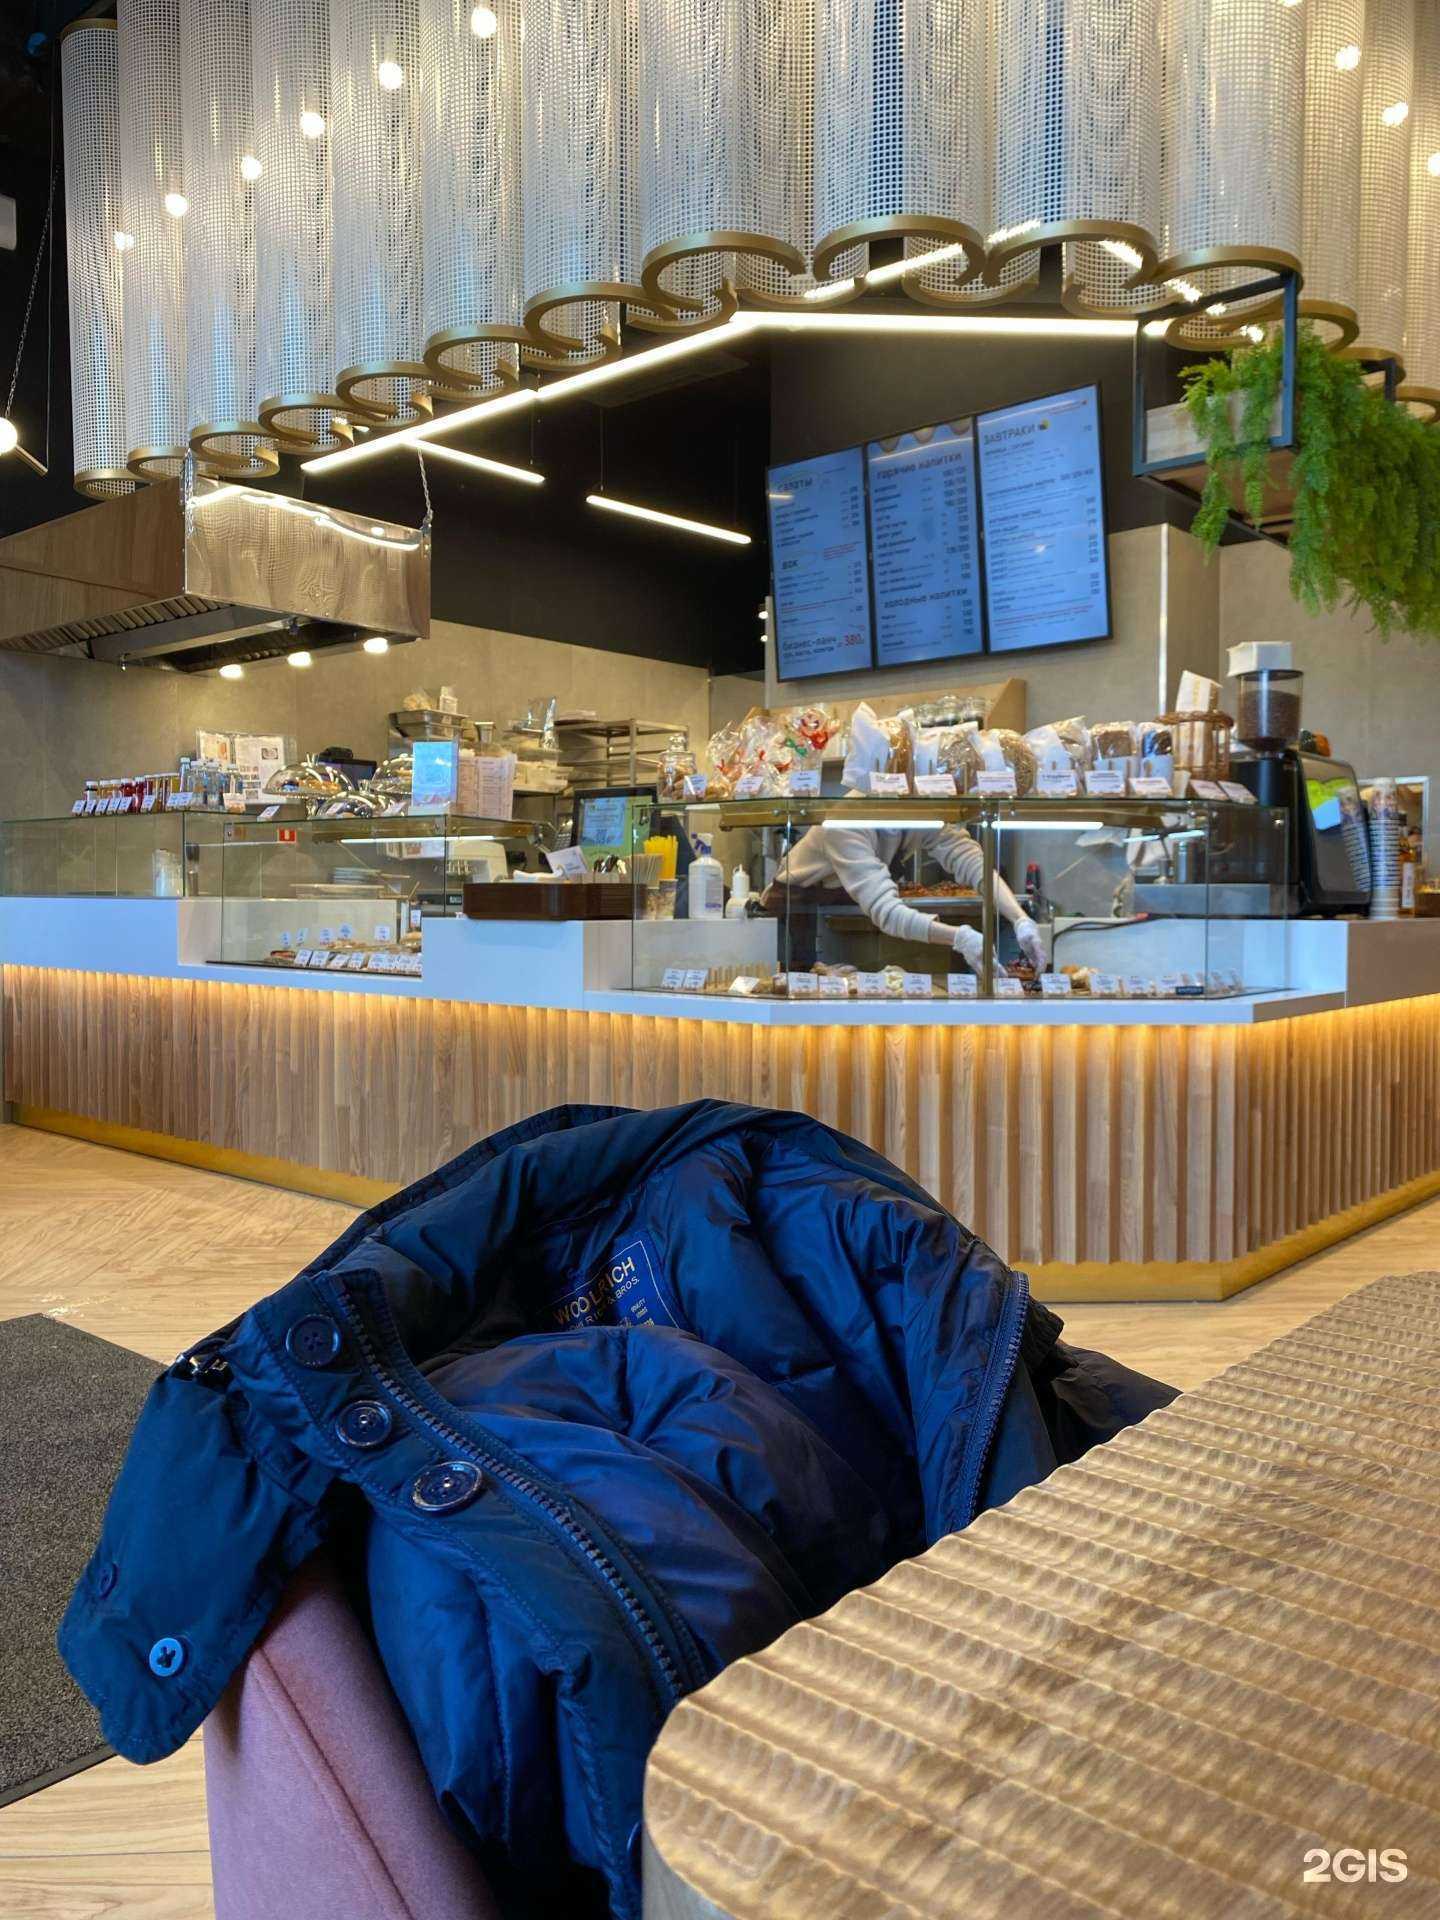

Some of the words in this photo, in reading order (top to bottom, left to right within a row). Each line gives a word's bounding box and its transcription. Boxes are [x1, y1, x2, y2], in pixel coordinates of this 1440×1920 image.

[983, 424, 1035, 446] ЗАВТРАКИ
[552, 1255, 636, 1326] WOOLRICH
[615, 1275, 641, 1299] BROS.
